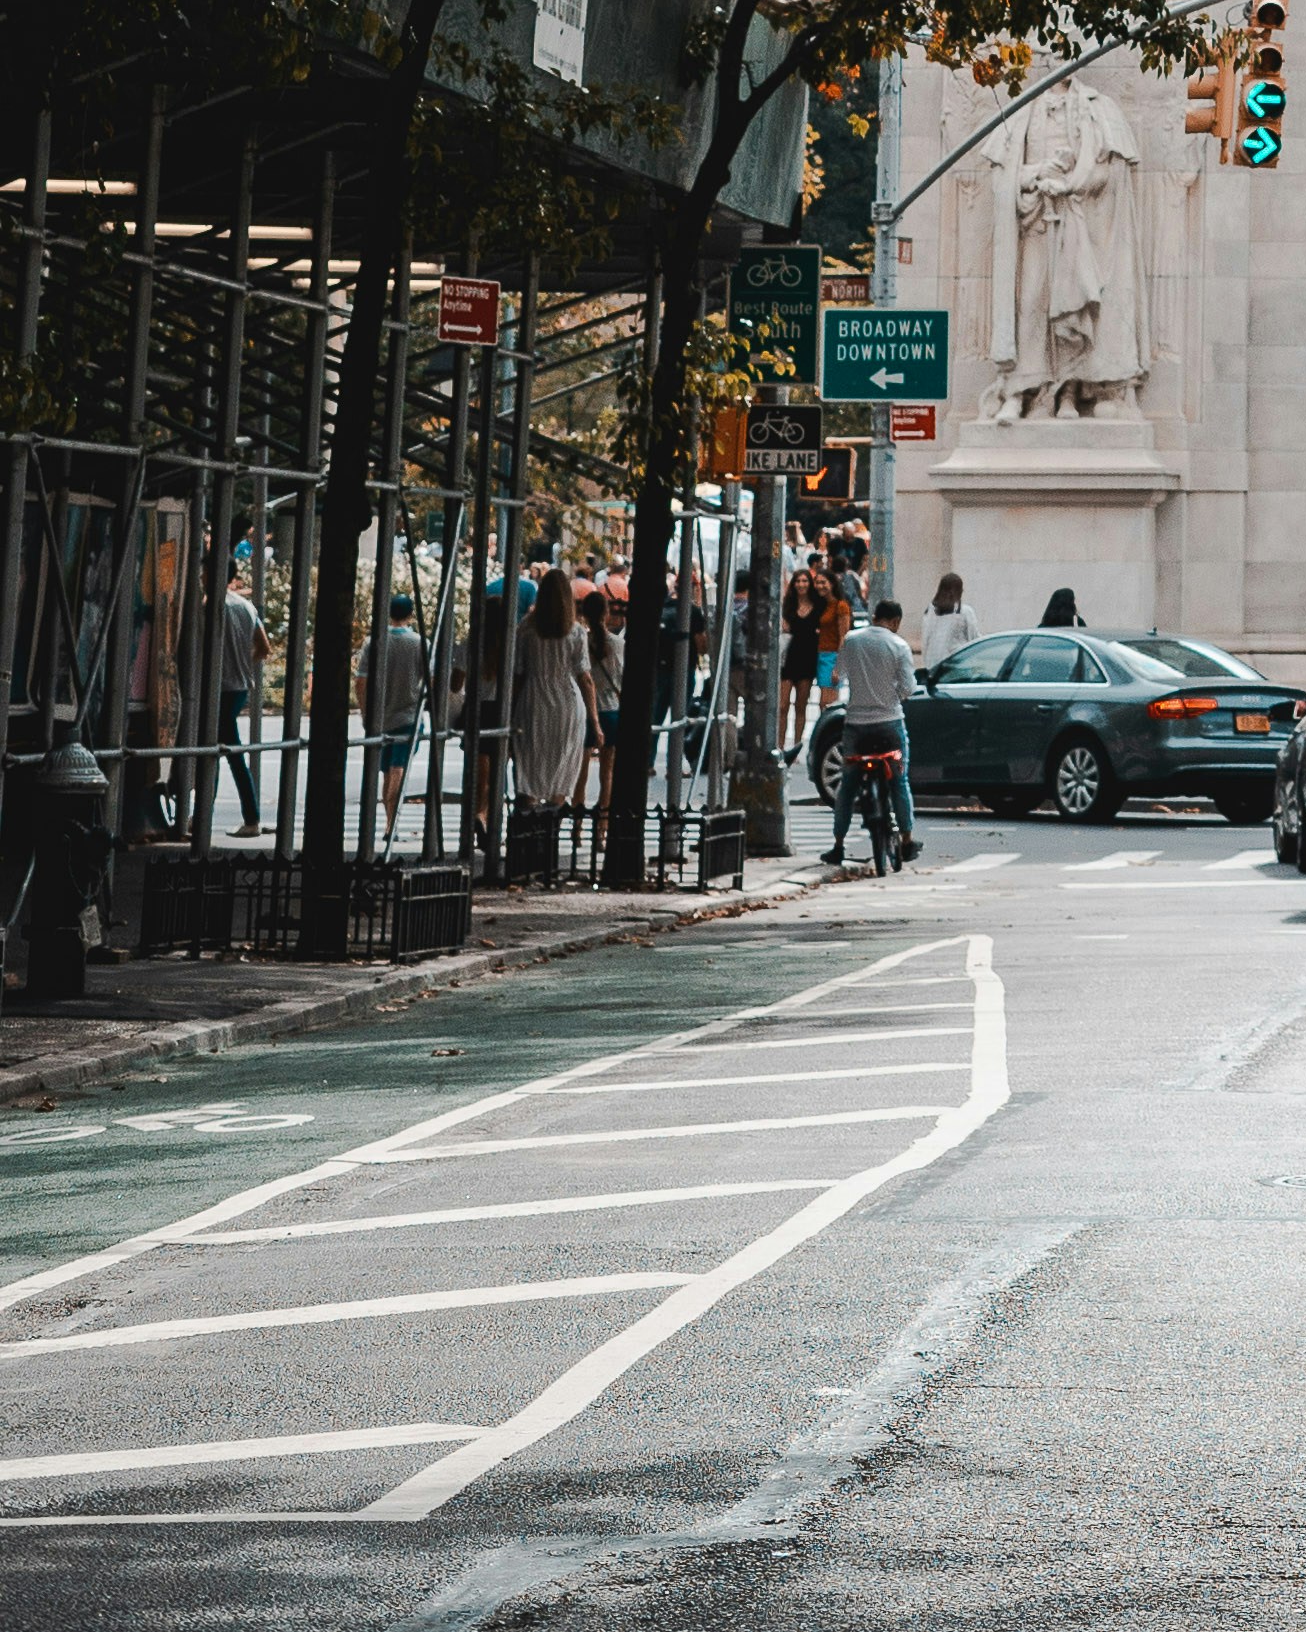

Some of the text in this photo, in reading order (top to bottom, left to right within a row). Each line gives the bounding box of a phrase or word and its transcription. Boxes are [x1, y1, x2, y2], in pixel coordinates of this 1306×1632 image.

[831, 285, 866, 299] NORTH
[734, 300, 813, 316] Best Route
[838, 319, 933, 337] BROADWAY
[836, 342, 936, 361] DOWNTOWN
[776, 451, 817, 470] LANE
